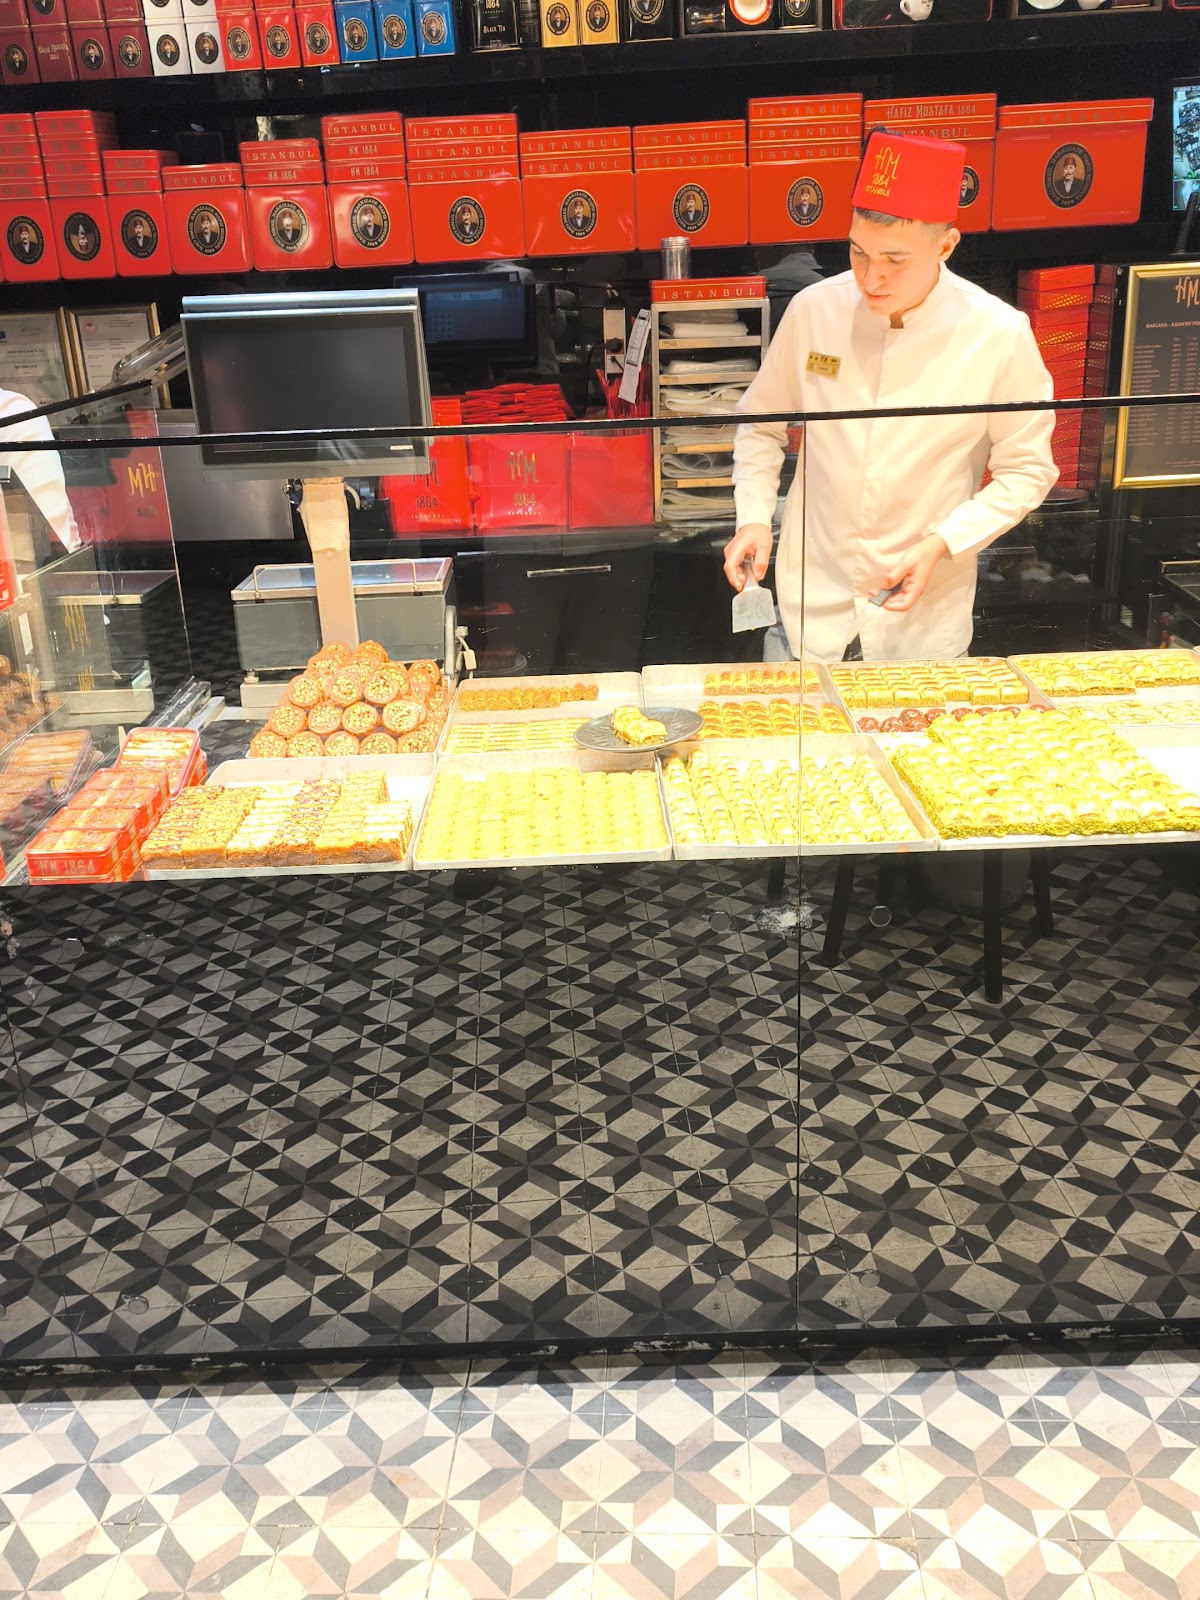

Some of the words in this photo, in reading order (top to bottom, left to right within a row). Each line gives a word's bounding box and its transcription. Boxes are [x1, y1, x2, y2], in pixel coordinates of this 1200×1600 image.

[886, 104, 912, 120] HAFIZ
[916, 102, 954, 119] MUSTAFA
[958, 104, 976, 116] 1864
[363, 144, 378, 155] 1864
[364, 165, 380, 176] 1864
[874, 147, 901, 180] HM
[1175, 276, 1200, 308] HM
[507, 450, 540, 485] HM
[417, 496, 438, 508] 1864
[64, 859, 95, 876] 1864
